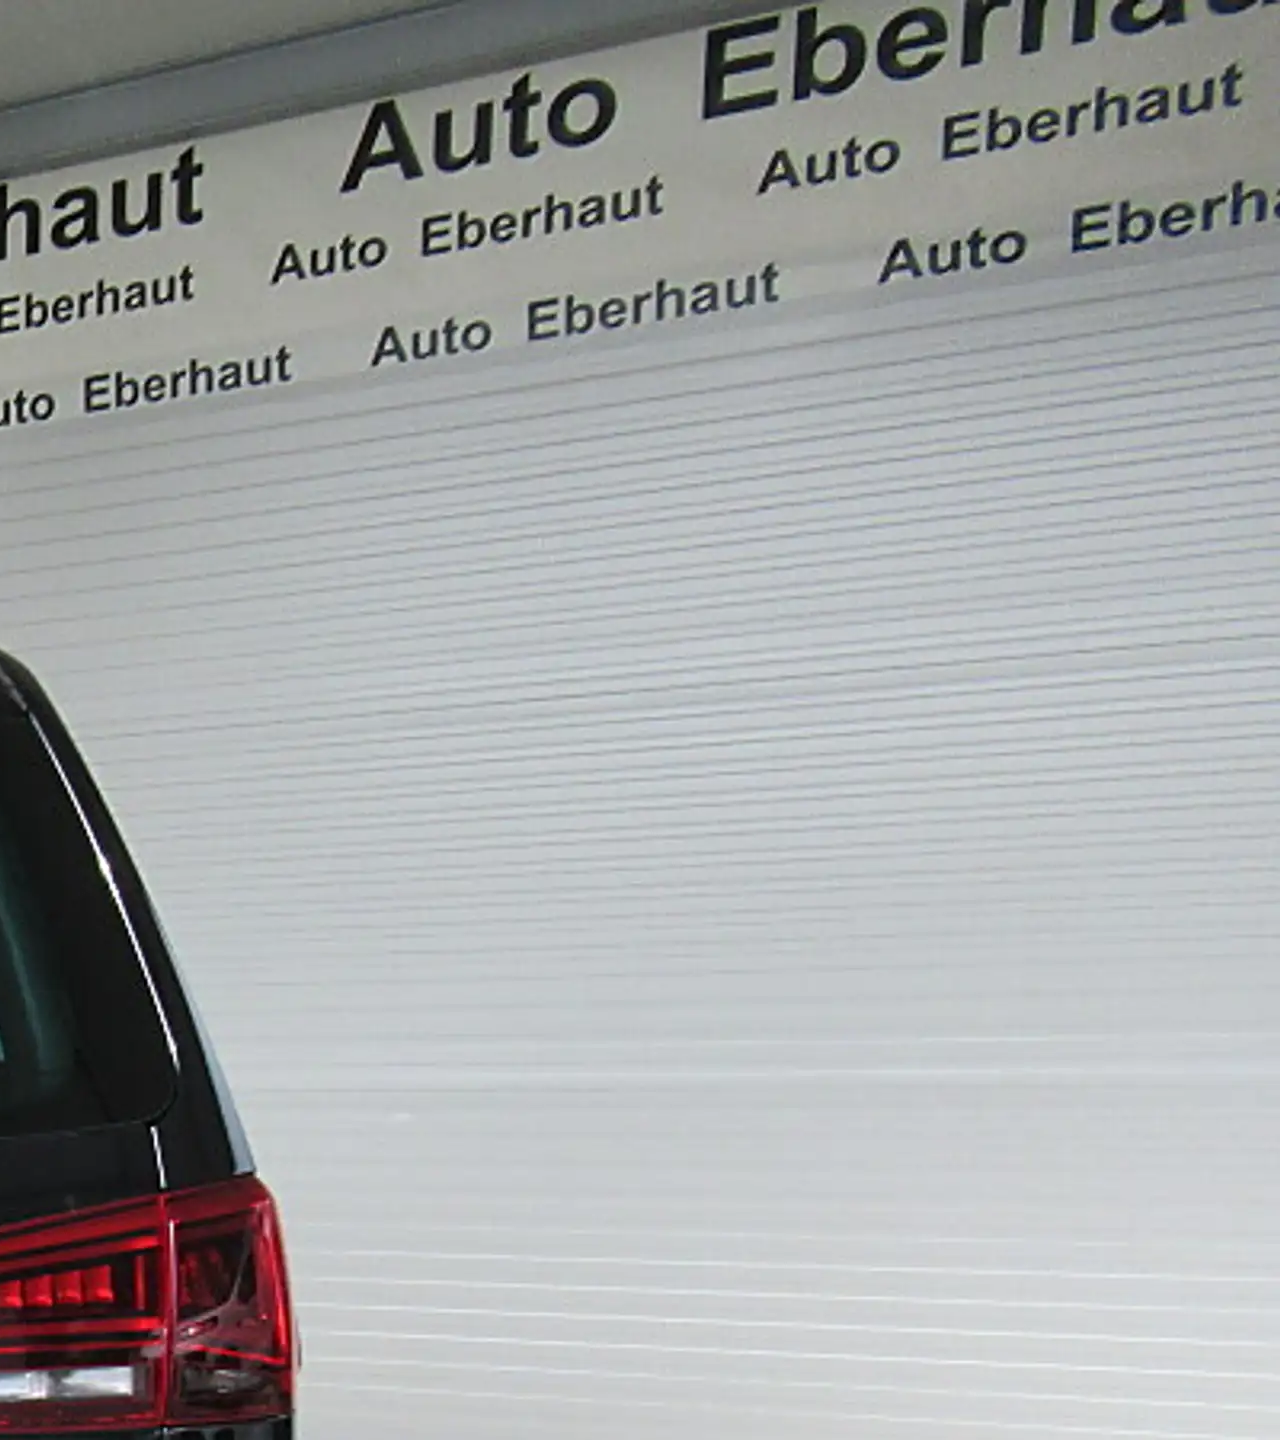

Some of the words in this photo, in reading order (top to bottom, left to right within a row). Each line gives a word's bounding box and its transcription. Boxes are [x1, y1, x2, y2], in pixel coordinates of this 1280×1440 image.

[339, 72, 617, 194] Auto
[757, 137, 900, 195] Auto
[942, 62, 1244, 161] Eberhaut
[271, 236, 387, 285] Auto
[421, 175, 663, 257] Eberhaut
[878, 228, 1028, 284] Auto
[1071, 178, 1280, 254] Eberh
[371, 319, 492, 367] Auto
[527, 263, 779, 341] Eberhaut
[84, 345, 291, 414] Eberhaut
